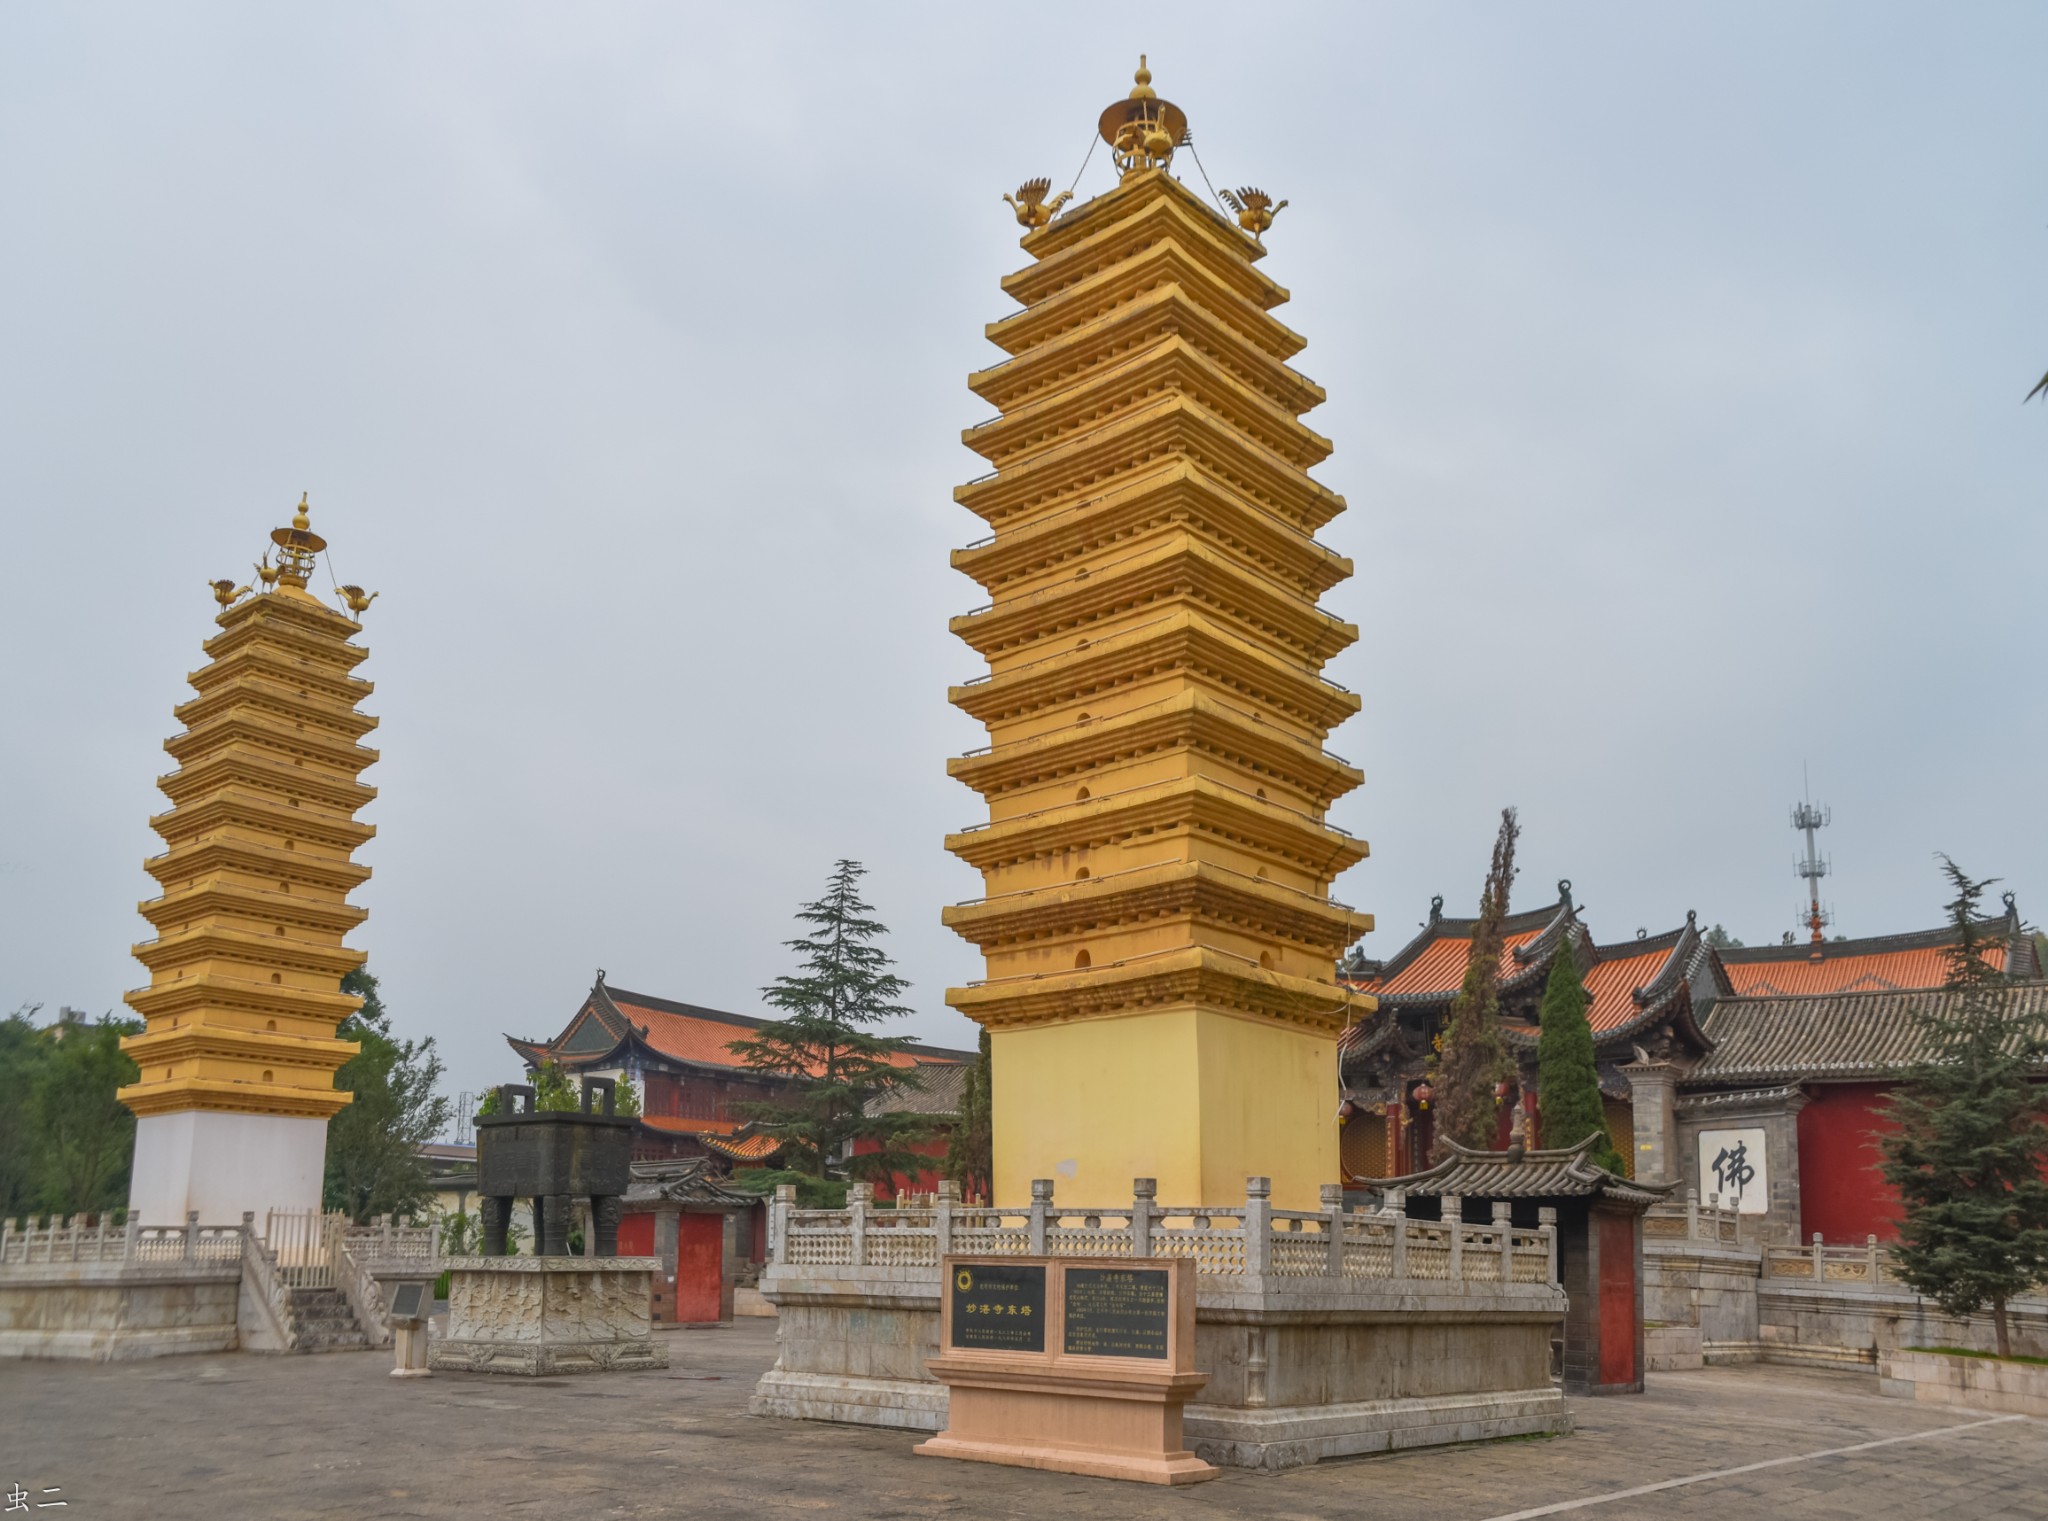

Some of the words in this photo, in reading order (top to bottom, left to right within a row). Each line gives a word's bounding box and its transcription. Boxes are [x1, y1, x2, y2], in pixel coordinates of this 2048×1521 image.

[1712, 1140, 1755, 1200] 佛
[965, 1303, 1032, 1316] 妙湛寺东塔
